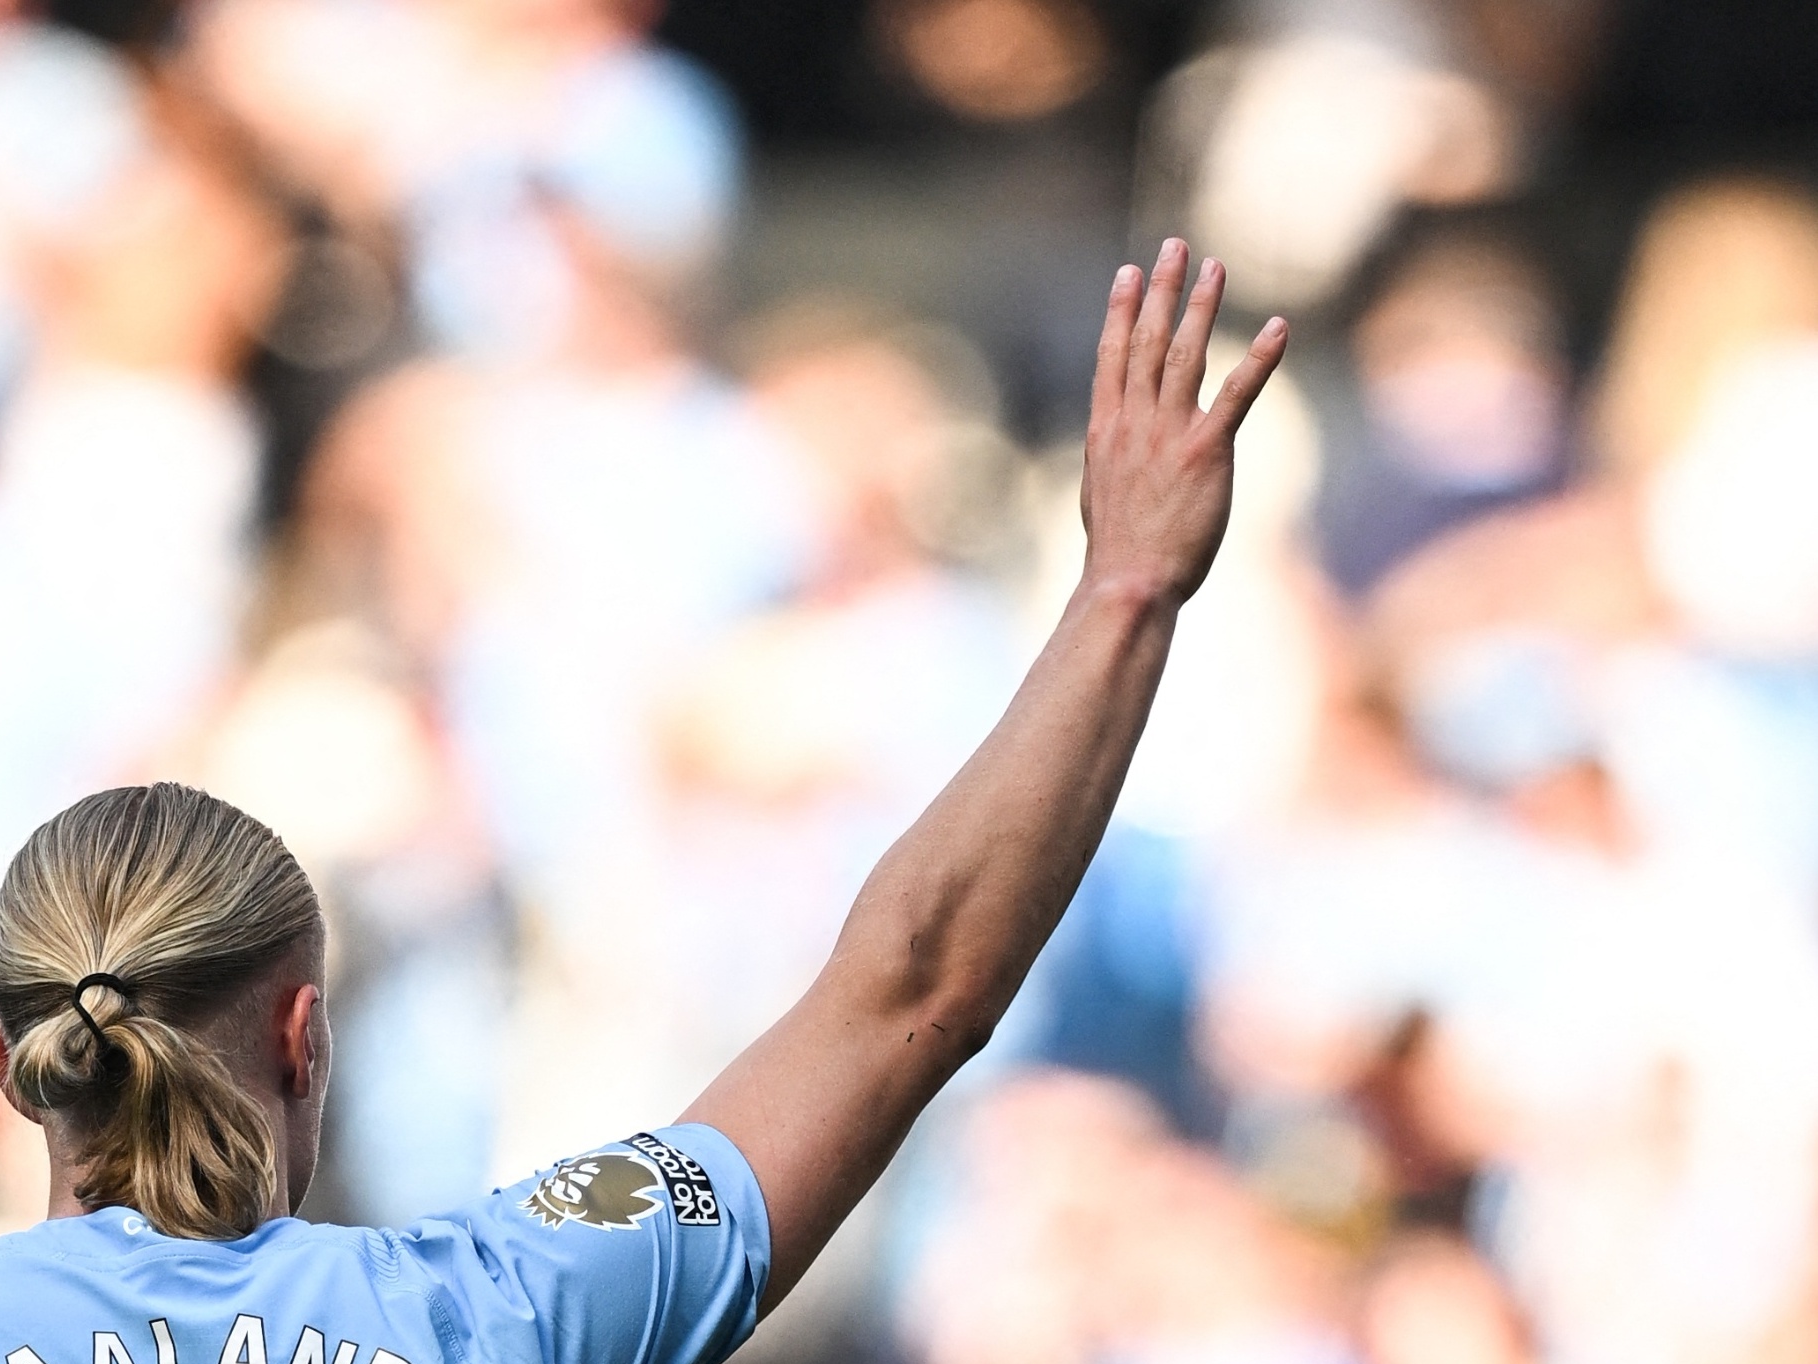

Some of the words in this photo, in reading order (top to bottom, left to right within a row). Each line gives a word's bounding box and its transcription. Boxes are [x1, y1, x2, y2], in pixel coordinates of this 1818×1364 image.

[632, 1137, 686, 1178] room
[674, 1183, 698, 1224] No
[692, 1184, 719, 1224] For
